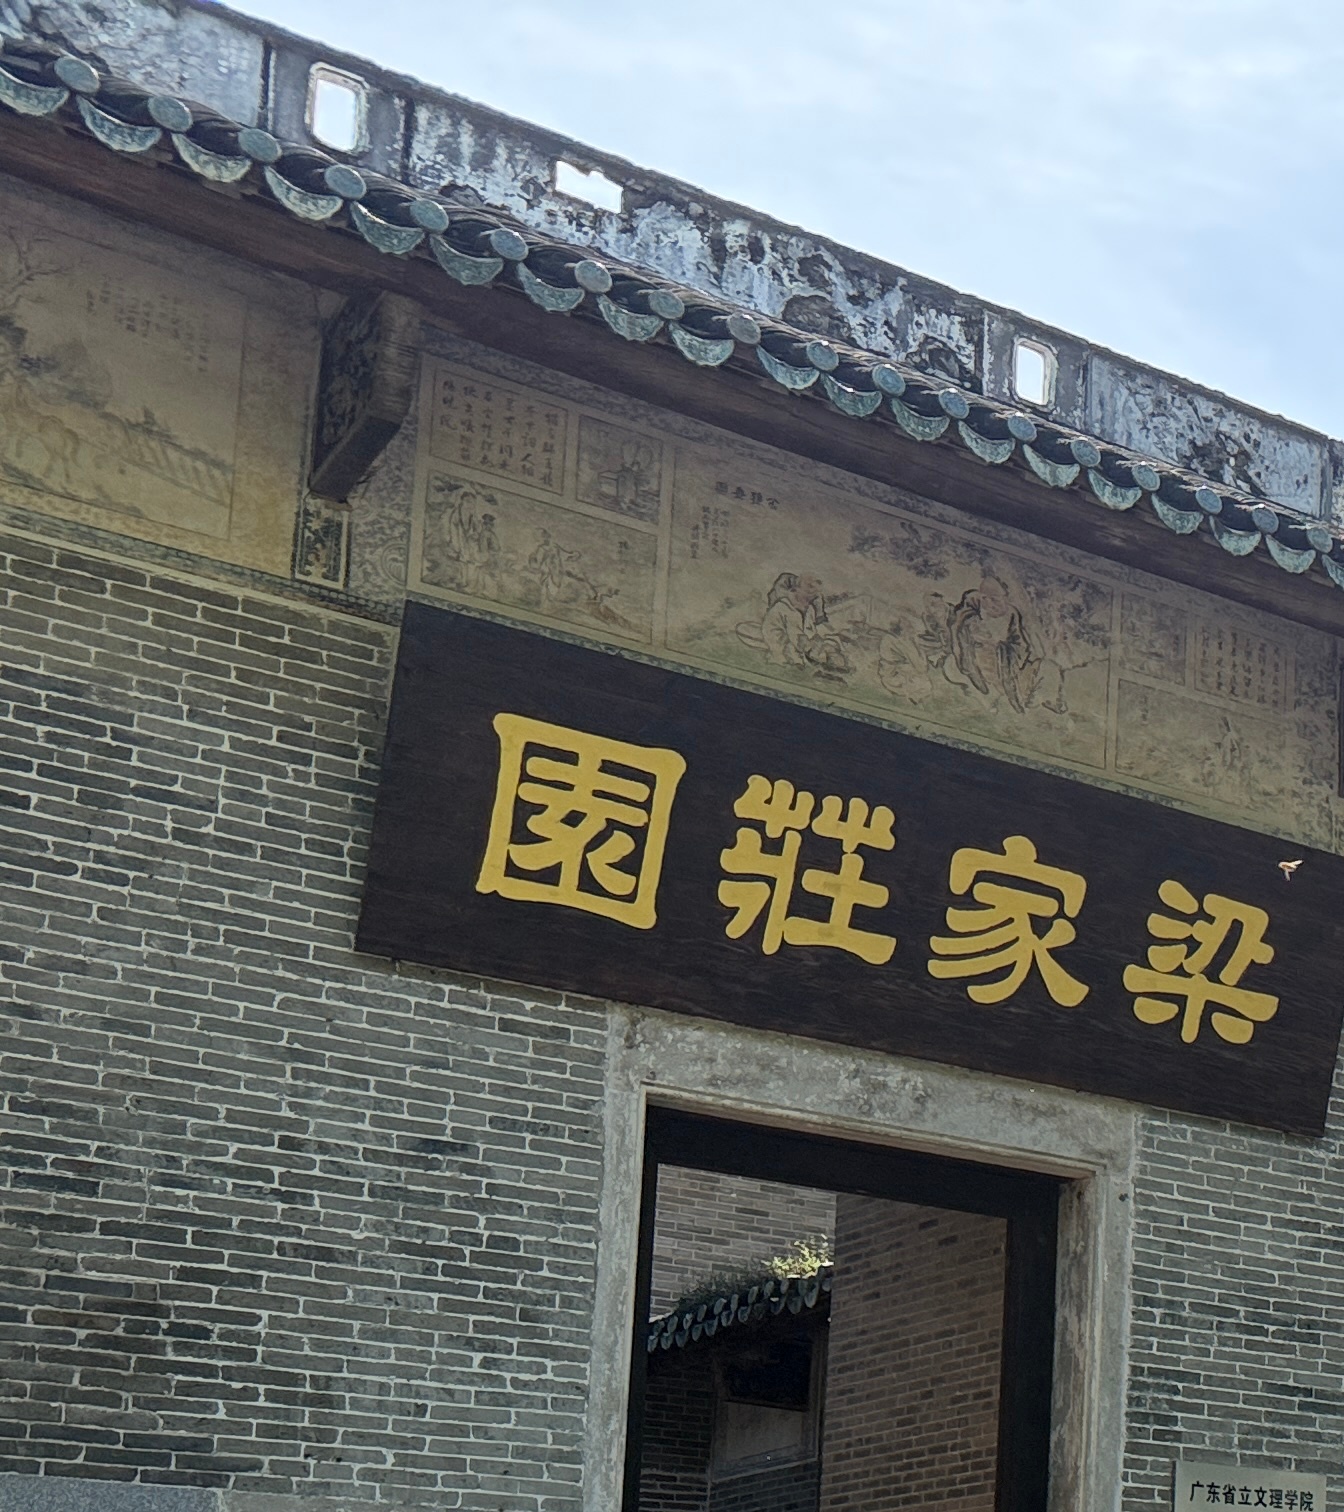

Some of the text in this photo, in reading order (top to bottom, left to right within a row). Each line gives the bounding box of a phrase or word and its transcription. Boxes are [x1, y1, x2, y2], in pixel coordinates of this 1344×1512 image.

[1190, 1481, 1313, 1511] 广东省立文理学院
